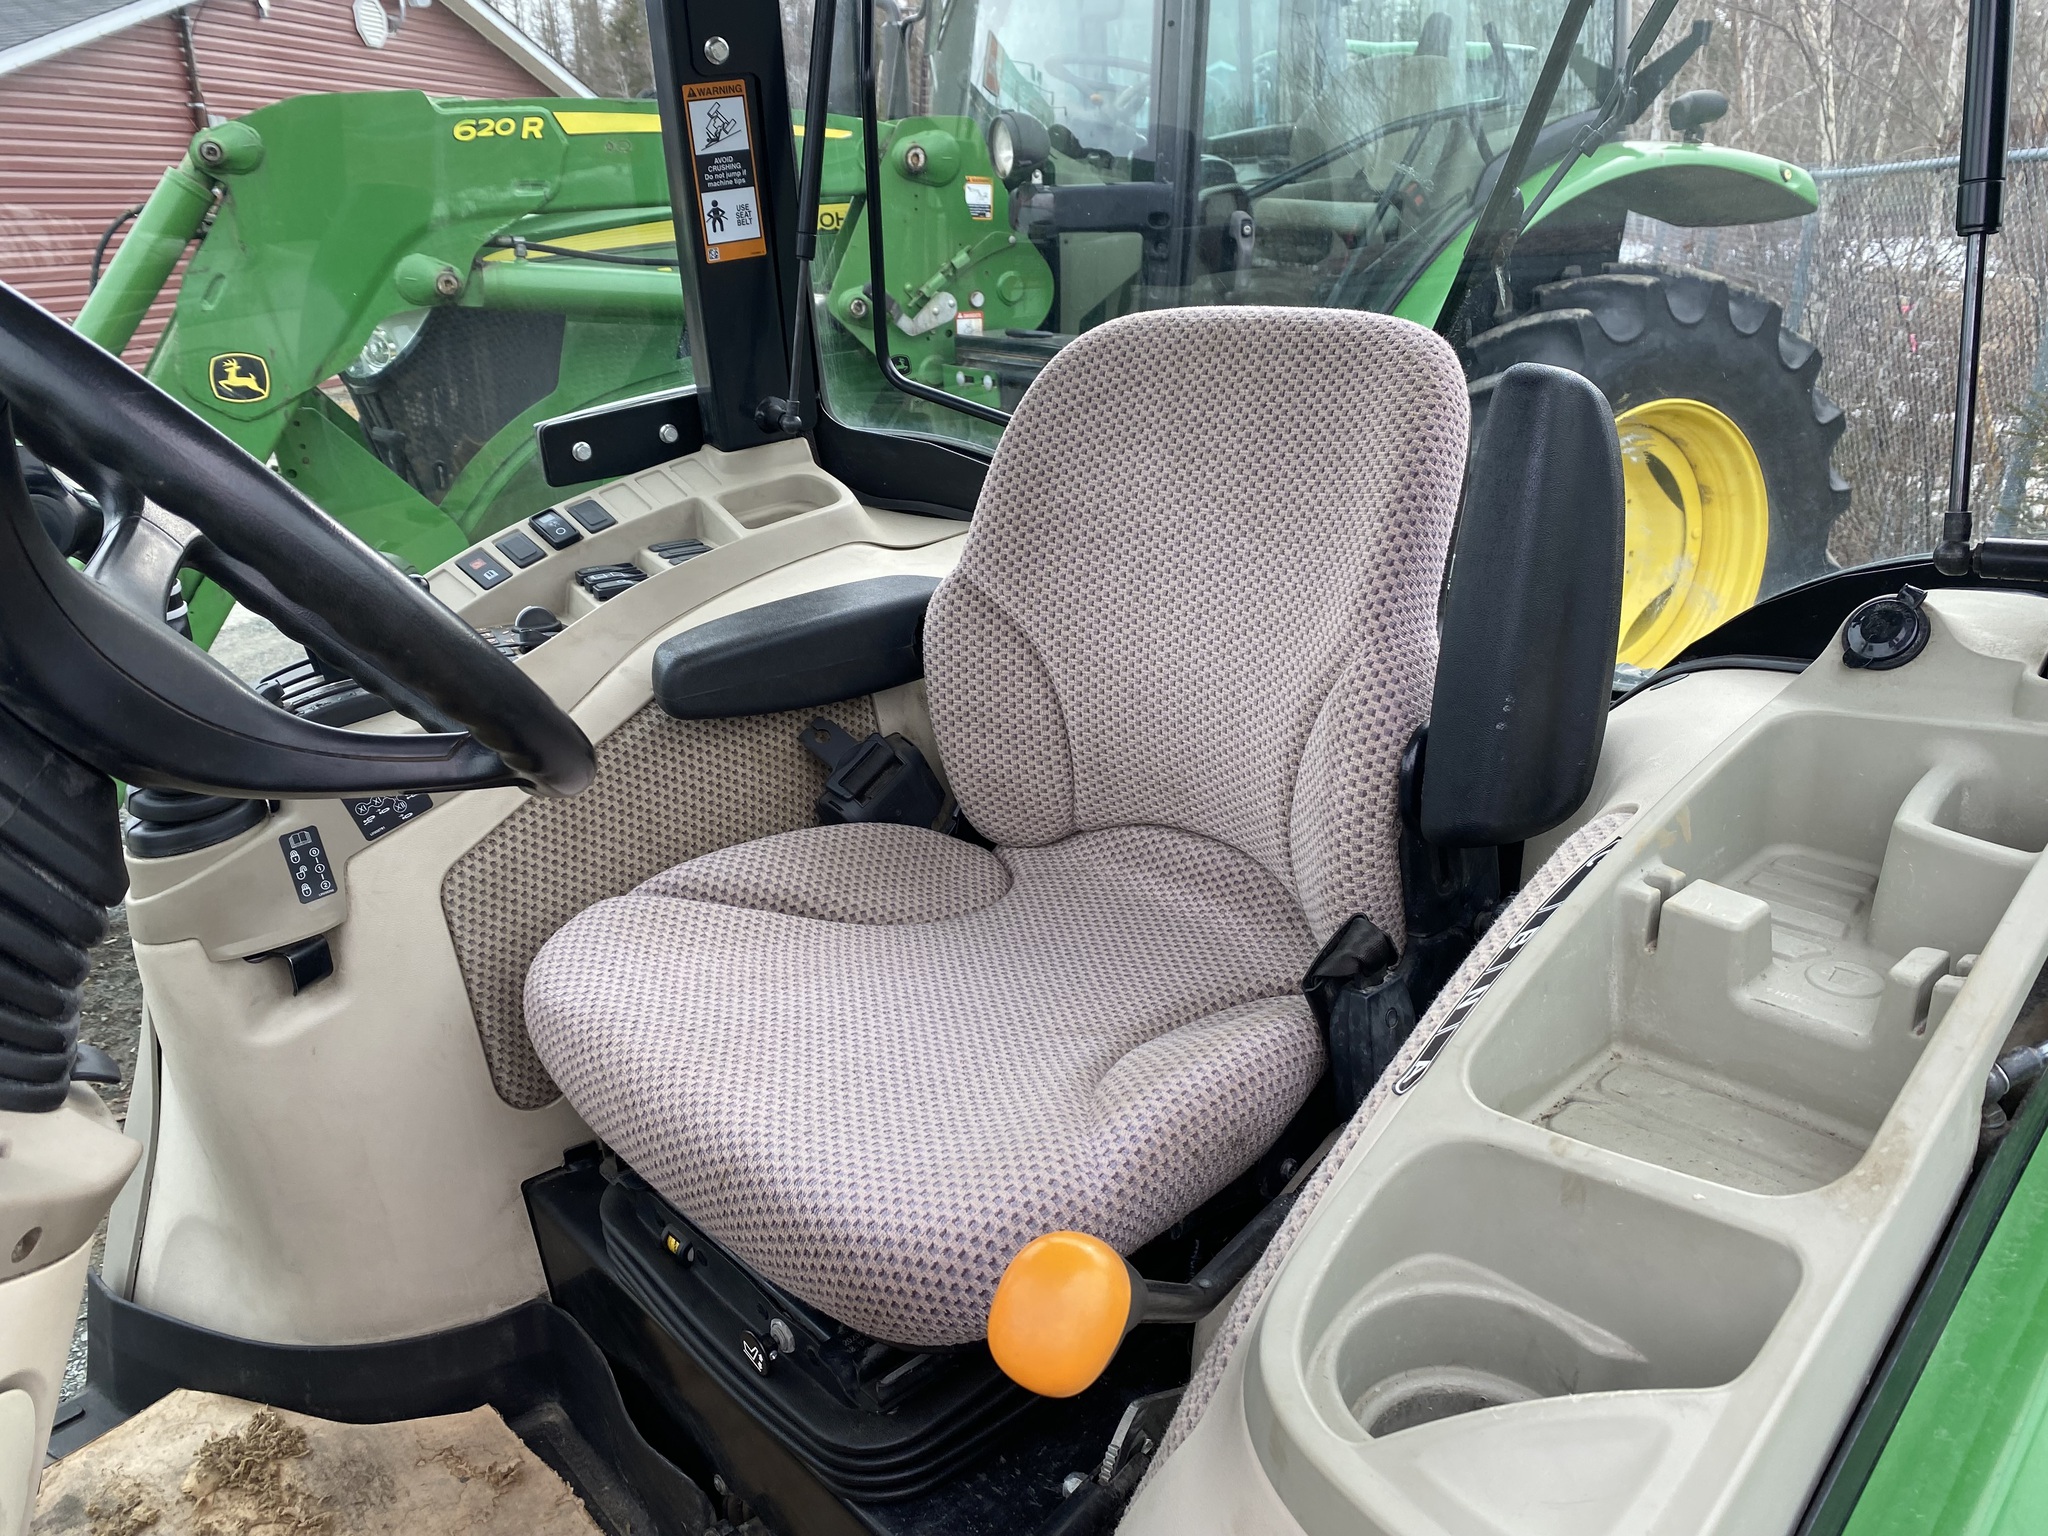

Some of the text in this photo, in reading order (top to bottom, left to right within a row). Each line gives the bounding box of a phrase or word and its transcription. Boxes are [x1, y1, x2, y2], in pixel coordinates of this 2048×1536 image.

[696, 84, 743, 97] WARNING
[453, 116, 544, 142] 620 R
[714, 155, 734, 164] AVOID
[708, 163, 742, 172] CRUSHING
[714, 171, 726, 179] not
[726, 170, 741, 180] jump
[708, 179, 733, 187] machine
[736, 203, 749, 211] USE
[735, 210, 752, 219] SEAT
[1509, 926, 1540, 949] B
[1402, 1060, 1431, 1083] A
